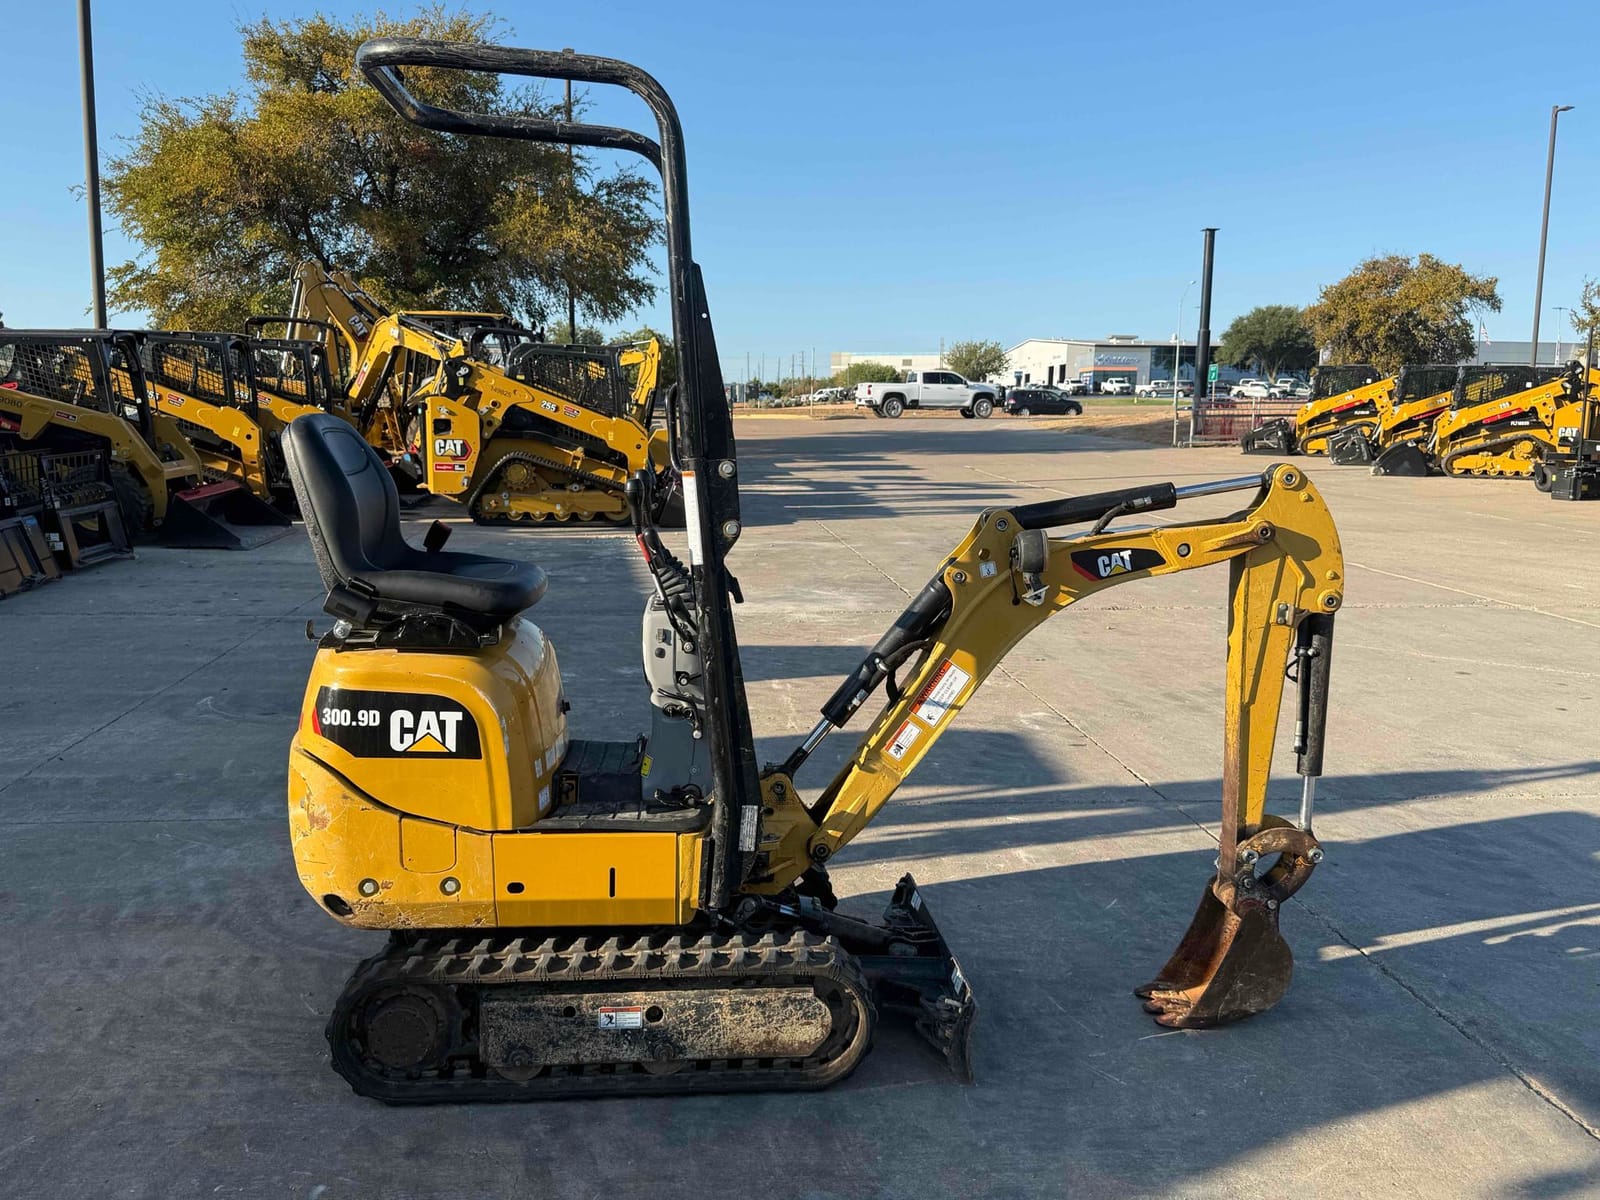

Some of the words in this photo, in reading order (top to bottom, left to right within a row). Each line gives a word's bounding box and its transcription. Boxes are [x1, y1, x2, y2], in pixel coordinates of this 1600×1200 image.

[348, 315, 368, 337] CAT
[541, 400, 557, 412] 255
[1558, 427, 1578, 437] CAT
[434, 439, 463, 457] CAT
[1097, 549, 1132, 577] CAT
[322, 707, 380, 726] 300.9D
[389, 709, 463, 752] CAT
